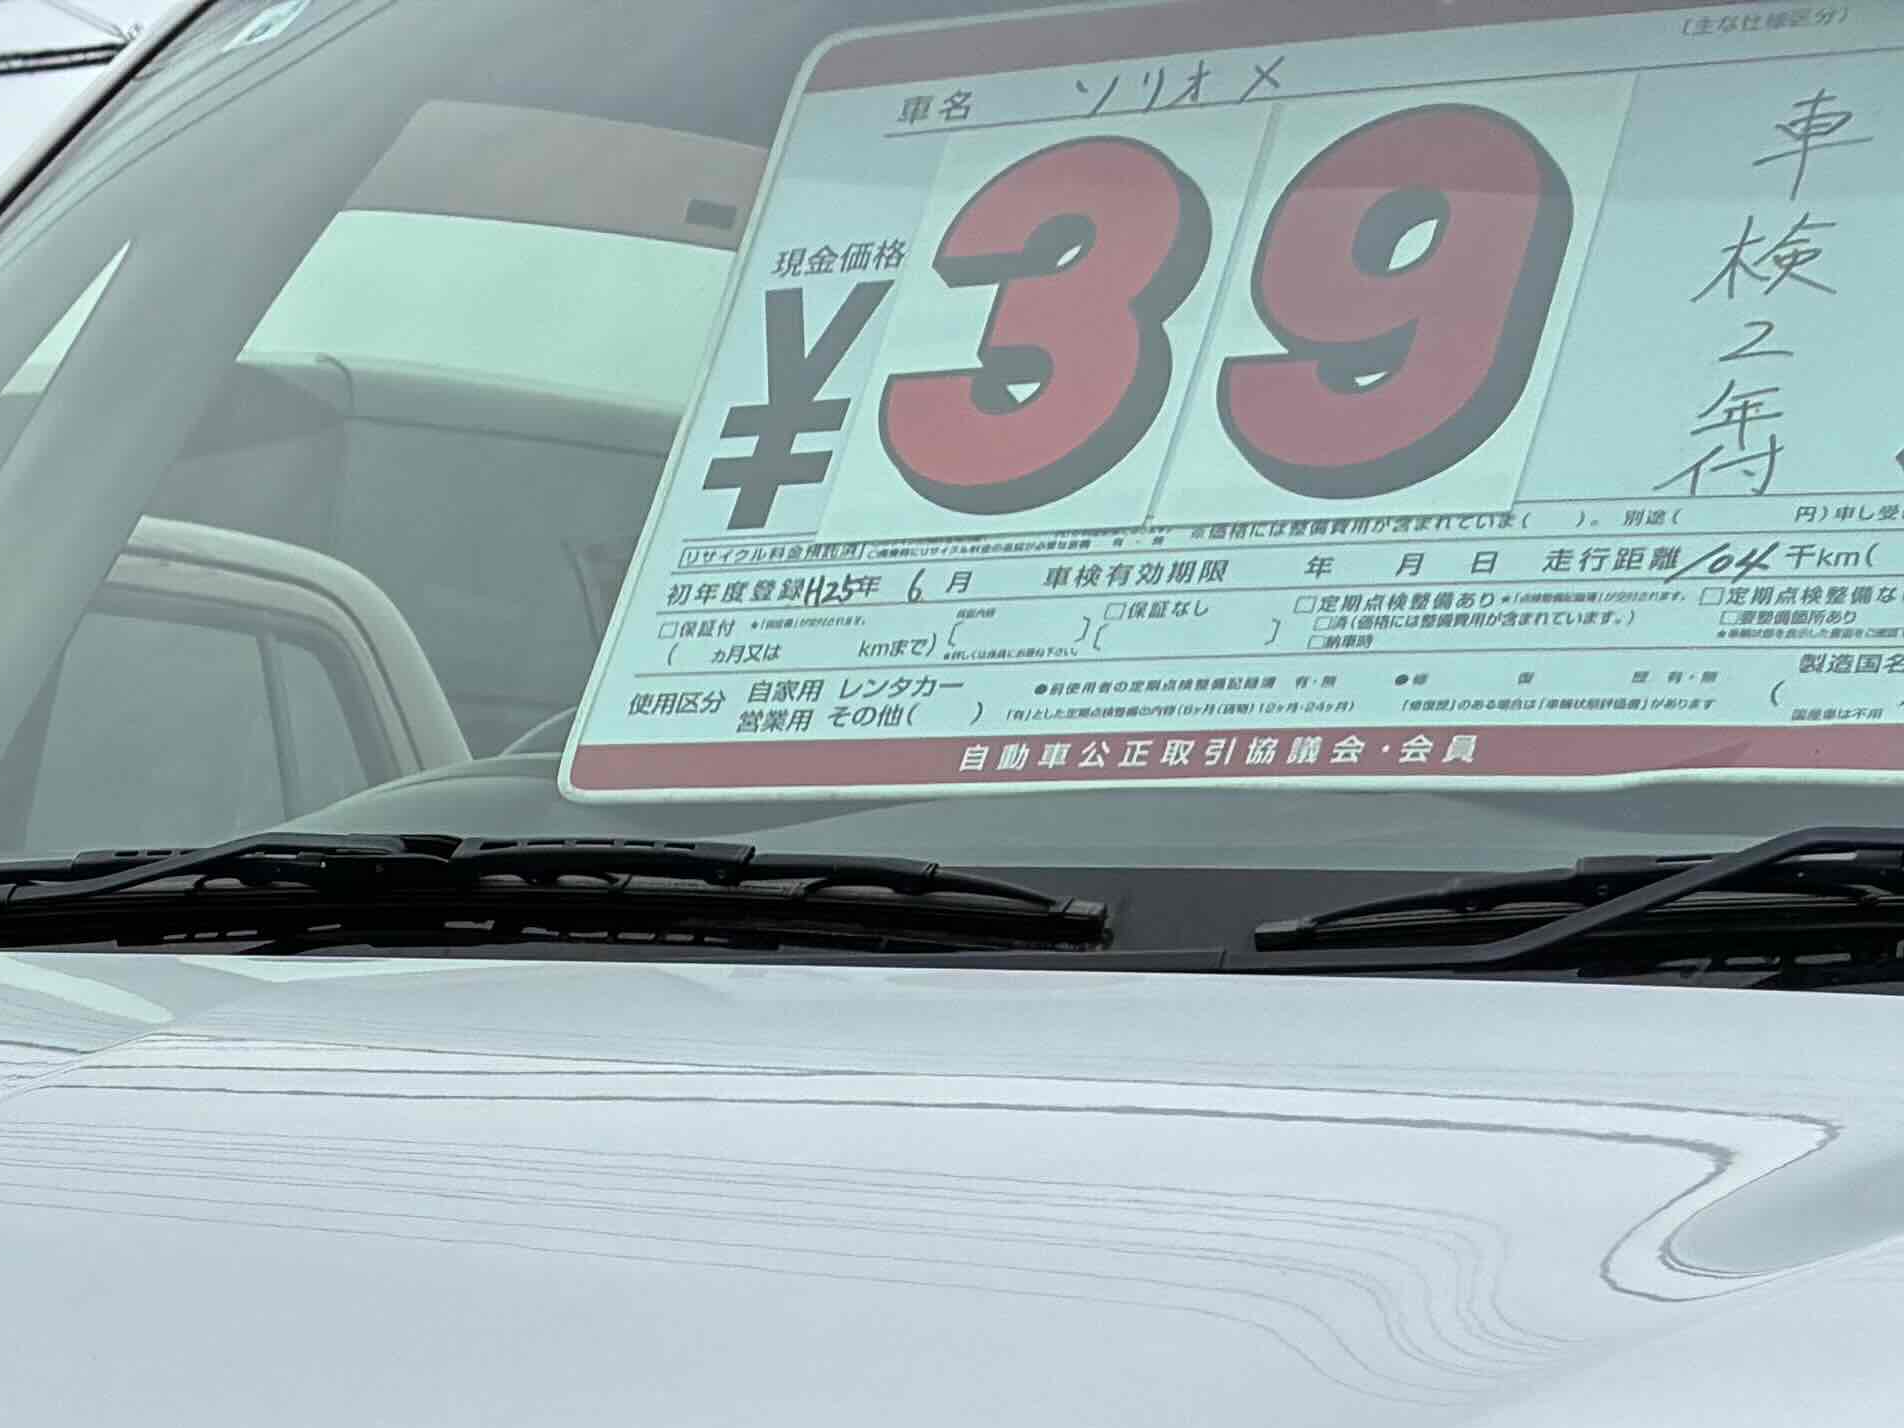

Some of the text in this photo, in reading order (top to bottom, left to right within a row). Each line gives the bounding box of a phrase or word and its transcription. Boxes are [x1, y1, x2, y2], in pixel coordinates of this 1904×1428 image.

[897, 91, 975, 125] 車名
[771, 239, 906, 278] 現金価格
[905, 568, 927, 603] 6
[945, 570, 974, 595] 月
[1042, 560, 1230, 589] 車検有効期限
[1303, 555, 1335, 579] 年
[1395, 552, 1425, 577] 月
[1469, 551, 1499, 575] 日
[1541, 545, 1682, 573] 走行距離
[679, 619, 736, 639] 保証付
[628, 689, 726, 716] 使用区分
[747, 678, 825, 704] 自家用
[838, 675, 965, 700] レンタカー
[735, 708, 814, 733] 営業用
[958, 734, 1478, 773] 自動車公正取引協議会・会員
